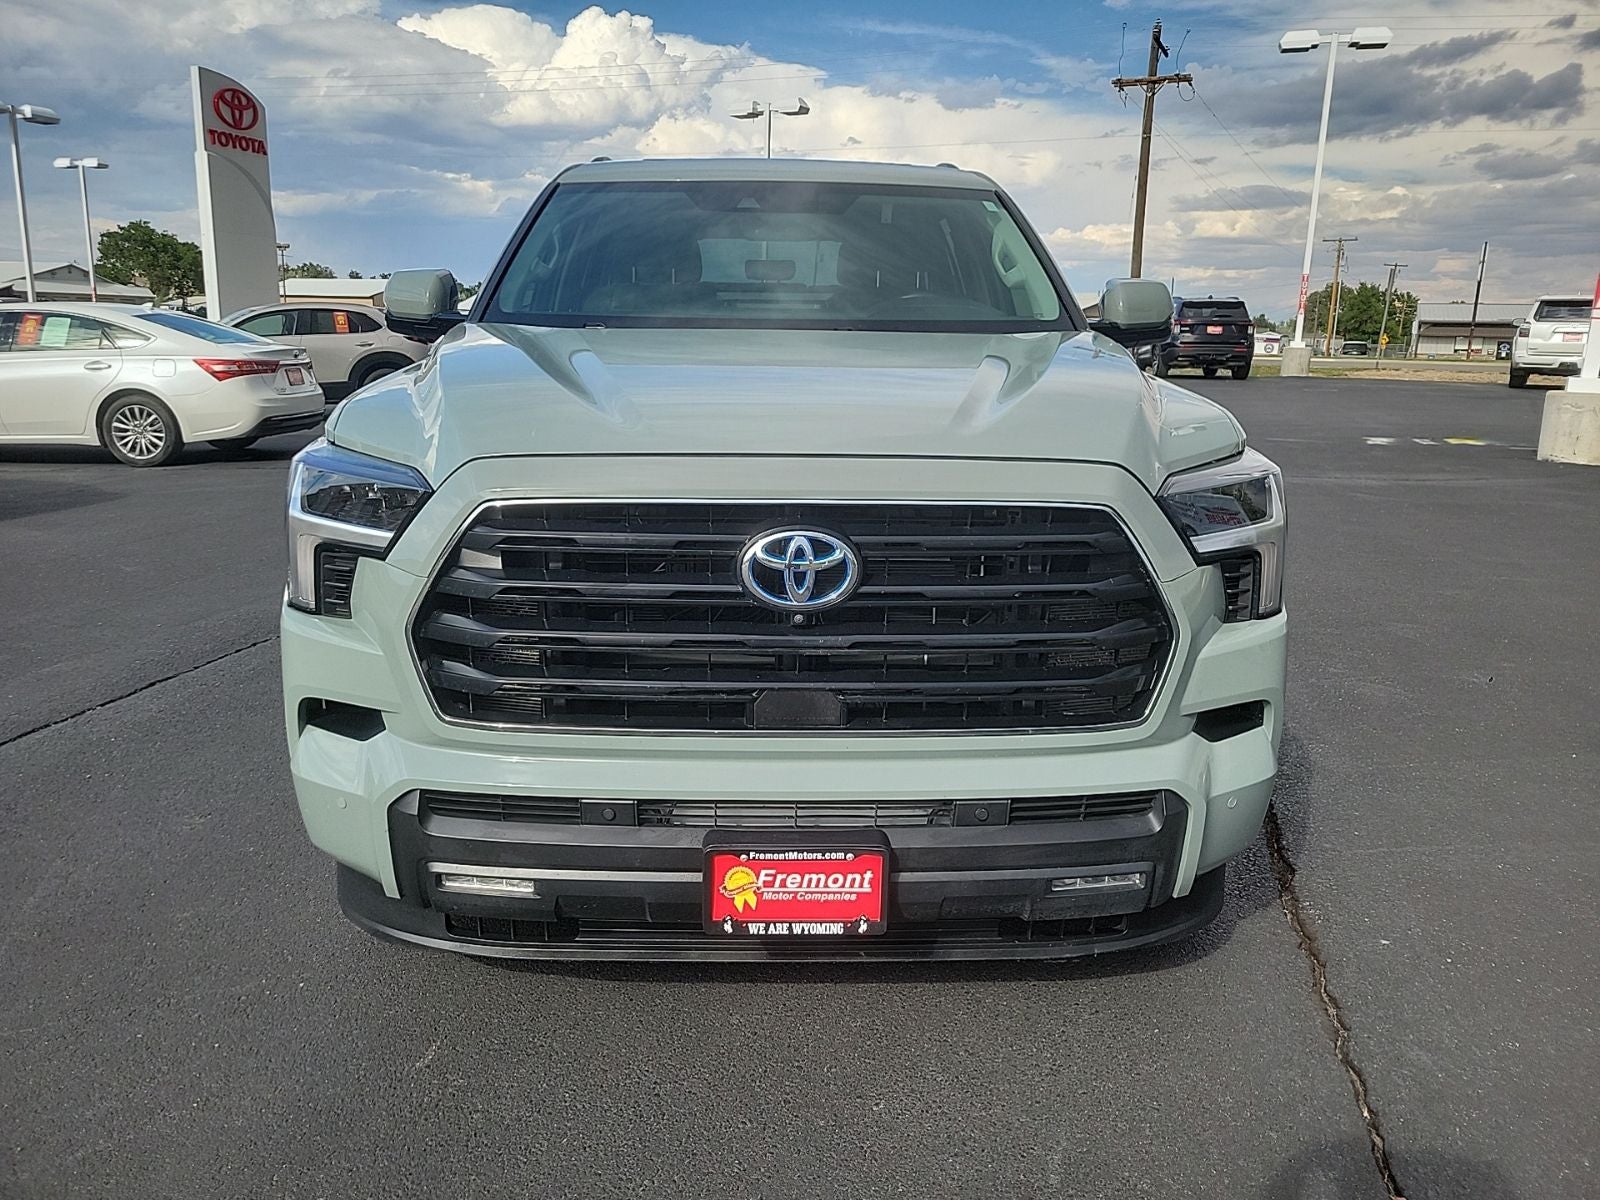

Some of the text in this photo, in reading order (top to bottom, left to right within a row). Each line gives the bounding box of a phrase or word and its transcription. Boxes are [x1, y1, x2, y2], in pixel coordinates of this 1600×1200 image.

[208, 129, 267, 155] TOYOTA
[1299, 274, 1308, 314] TOYOTA
[749, 851, 845, 860] FremontMotors.com
[758, 869, 874, 888] Fremont
[762, 892, 857, 902] Motor Companies
[748, 923, 844, 934] WE ARE WYOMING
